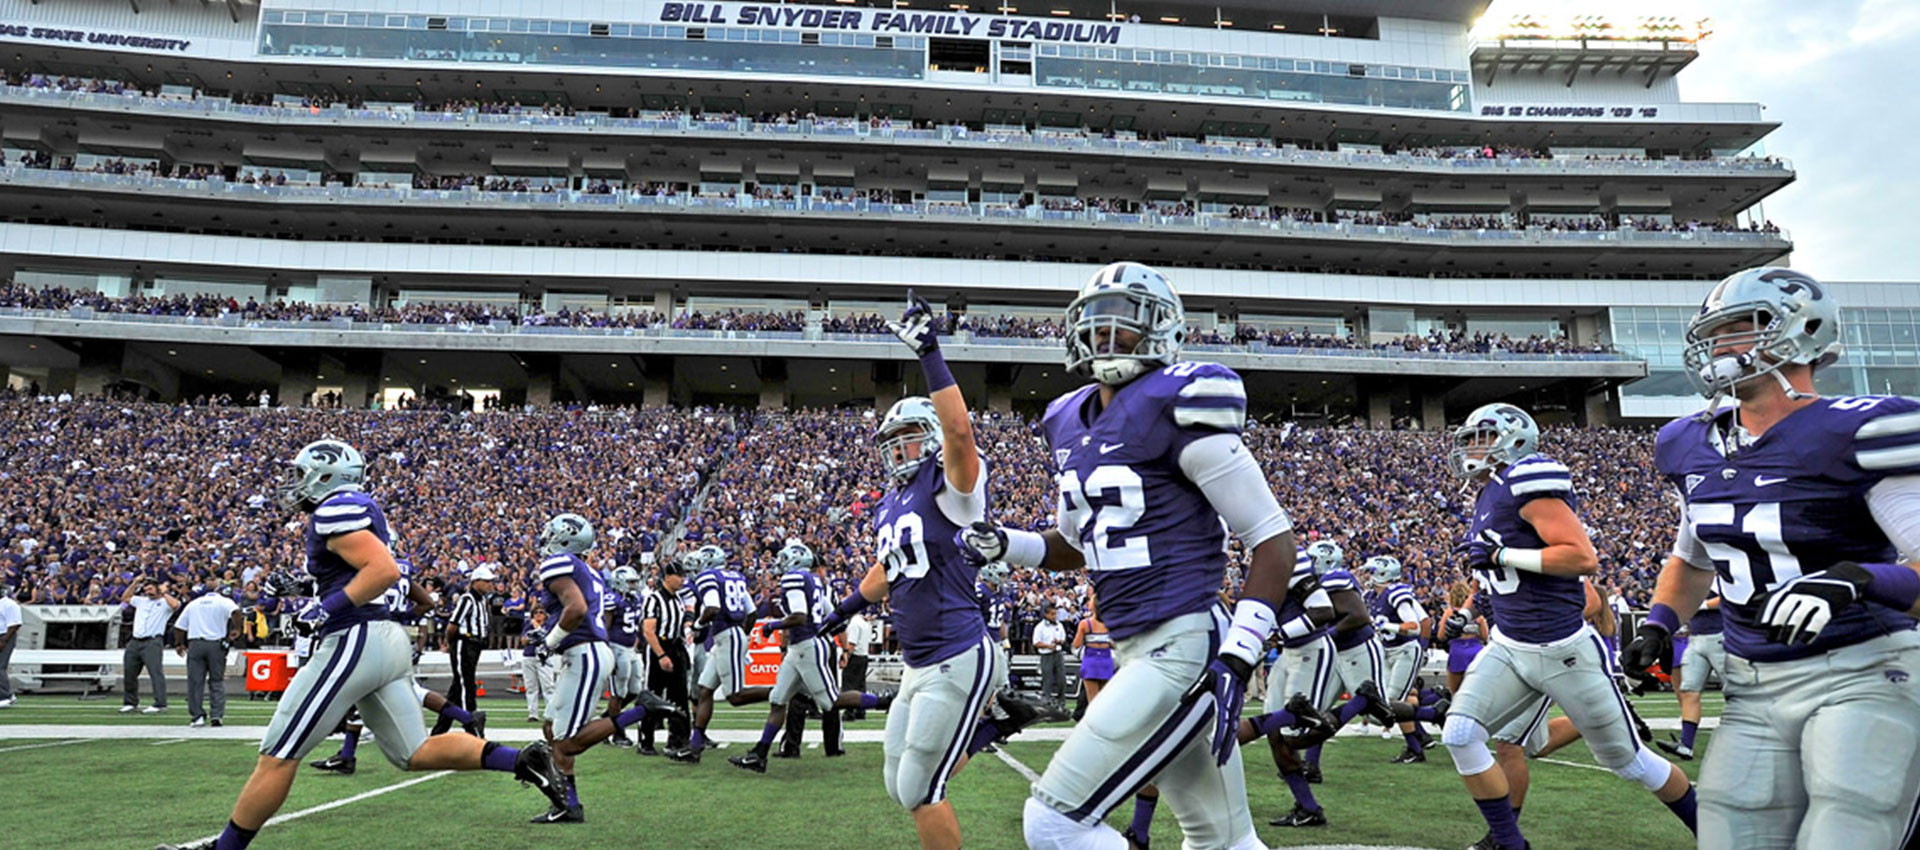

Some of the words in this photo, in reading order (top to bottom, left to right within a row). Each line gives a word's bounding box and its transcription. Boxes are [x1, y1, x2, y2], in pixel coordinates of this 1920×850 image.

[30, 27, 85, 42] STATE
[87, 32, 190, 51] UNIVERSITY
[660, 2, 726, 23] BILL
[737, 6, 862, 30] SNYDER
[871, 13, 980, 35] FAMILY
[987, 19, 1120, 44] STADIUM
[1481, 106, 1504, 116] BIG
[1526, 106, 1604, 117] CHAMPIONS
[1055, 465, 1152, 571] 22
[1687, 503, 1803, 605] 51
[252, 659, 271, 680] G
